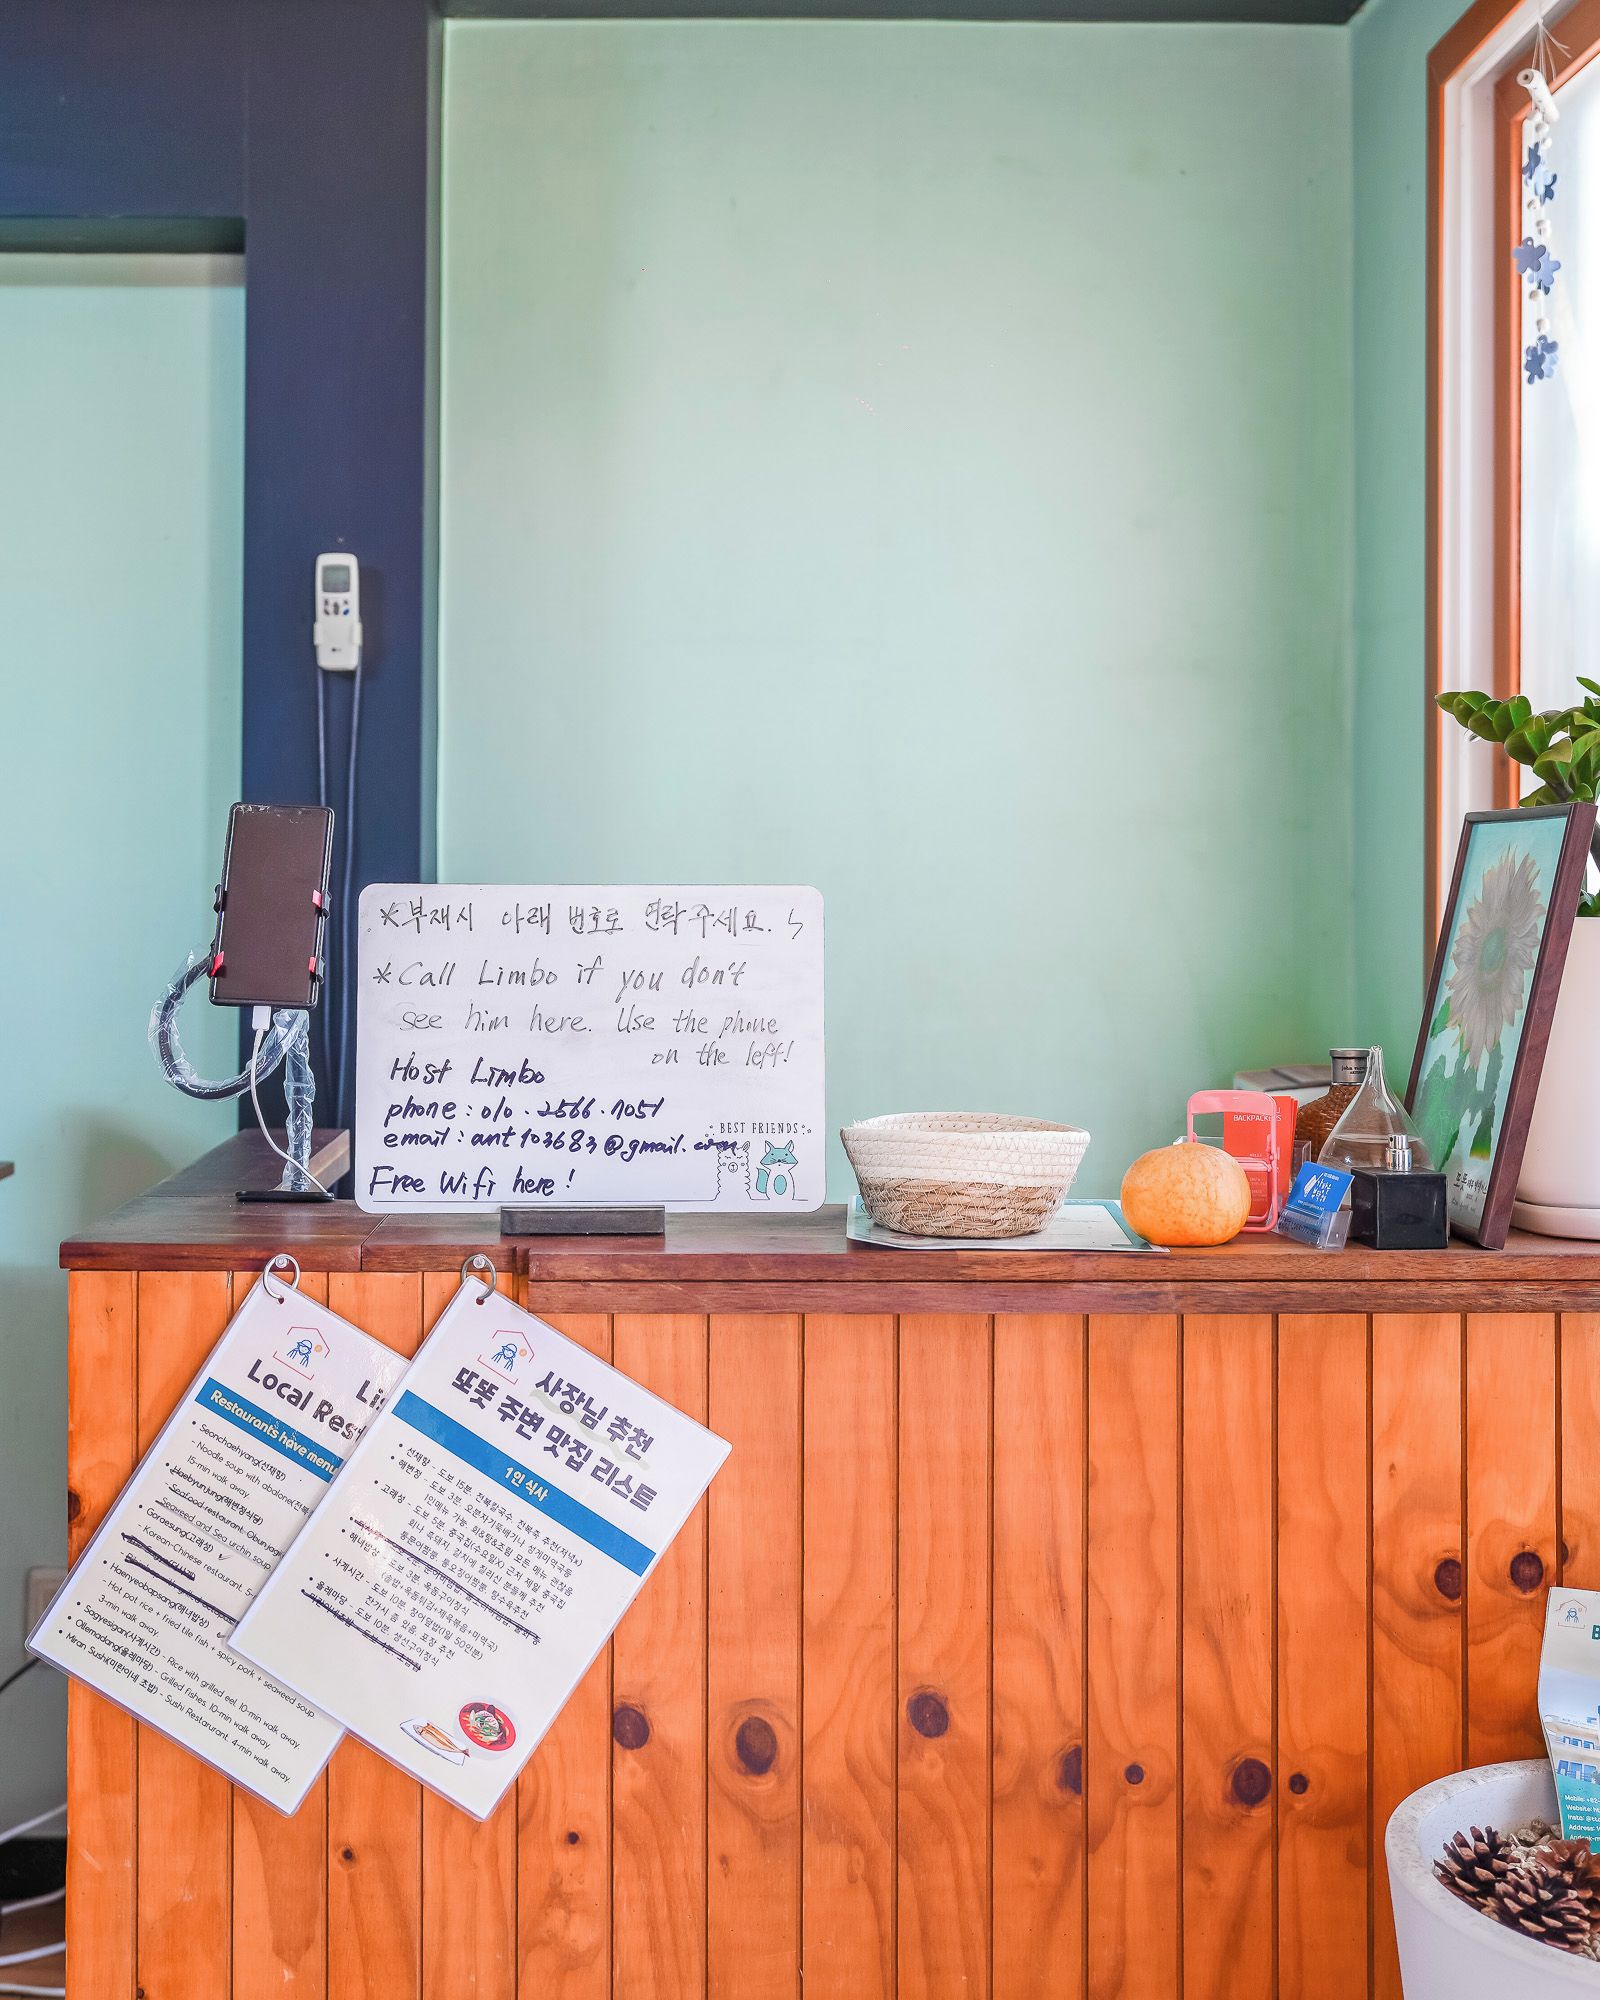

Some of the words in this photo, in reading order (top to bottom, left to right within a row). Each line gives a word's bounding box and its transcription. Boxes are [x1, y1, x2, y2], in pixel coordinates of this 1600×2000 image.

[502, 903, 551, 935] 아래
[569, 905, 624, 935] 번호로
[399, 962, 456, 986] Call
[478, 957, 558, 986] Limbo
[577, 955, 604, 984] if
[615, 969, 663, 1003] you
[681, 956, 746, 988] don't
[465, 1003, 509, 1031] him
[530, 1003, 592, 1033] here.
[617, 1004, 655, 1034] Use
[673, 1009, 708, 1033] the
[718, 1010, 778, 1039] phone
[390, 1051, 452, 1084] Host
[471, 1057, 545, 1087] Limbo
[651, 1049, 678, 1064] on
[696, 1041, 730, 1066] the
[746, 1040, 794, 1069] left!
[720, 1122, 746, 1134] BEST
[752, 1122, 799, 1134] FRIENDS
[369, 1166, 426, 1196] Free
[440, 1166, 496, 1200] Wifi
[247, 1358, 313, 1411] Local
[210, 1389, 279, 1438] Restaurants
[278, 1431, 307, 1456] have
[534, 1370, 608, 1430] 사장님
[606, 1415, 654, 1460] 추천
[186, 1455, 210, 1473] 15-min
[211, 1472, 228, 1485] walk
[196, 1441, 223, 1462] Noodle
[224, 1460, 243, 1474] soup
[245, 1472, 260, 1485] with
[406, 1447, 430, 1466] 선채향
[437, 1468, 454, 1483] 도보
[496, 1394, 544, 1440] 주변
[543, 1424, 593, 1472] 맛집
[590, 1456, 657, 1511] 리스트
[398, 1459, 422, 1479] 해변정
[429, 1480, 446, 1495] 도보
[505, 1467, 525, 1487] 1인
[525, 1479, 548, 1501] 식사
[142, 1525, 202, 1565] Korean-Chinese
[146, 1507, 213, 1552] Goraesung(고래성)
[159, 1495, 196, 1523] Seaweed
[194, 1517, 212, 1533] and
[211, 1527, 229, 1543] Sea
[227, 1538, 253, 1558] urchin
[380, 1484, 405, 1503] 고래성
[412, 1505, 429, 1520] 도보
[505, 1565, 523, 1581] 근처
[524, 1577, 540, 1593] 제일
[542, 1589, 566, 1609] 중국집
[332, 1557, 364, 1581] 사계시간
[371, 1582, 388, 1597] 도보
[407, 1518, 424, 1533] 회나
[528, 1597, 544, 1612] 추천
[513, 1553, 530, 1568] 모든
[532, 1565, 546, 1579] 메뉴
[98, 1594, 119, 1612] 3-min
[121, 1609, 137, 1622] walk
[138, 1621, 158, 1637] away.
[315, 1580, 347, 1605] 올레마당
[354, 1607, 372, 1622] 도보
[393, 1632, 439, 1666] 생선구이정식
[364, 1595, 389, 1616] 잔가시
[419, 1632, 436, 1647] 포장
[438, 1644, 455, 1659] 추천
[107, 1580, 122, 1594] Hot
[122, 1592, 138, 1603] pot
[138, 1601, 153, 1613] rice
[161, 1613, 181, 1629] fried
[181, 1626, 193, 1637] tile
[194, 1634, 208, 1648] fish
[216, 1650, 236, 1666] spicy
[236, 1663, 255, 1678] pork
[263, 1680, 296, 1704] seaweed
[295, 1702, 314, 1718] soup.
[83, 1604, 160, 1656] Sagyesigan(사계시간)
[166, 1656, 183, 1671] Rice
[184, 1669, 199, 1681] with
[199, 1680, 224, 1697] grilled
[238, 1702, 261, 1723] 10-min
[263, 1720, 278, 1734] walk
[280, 1732, 300, 1749] away.
[65, 1632, 86, 1650] Miran
[164, 1694, 184, 1711] Sushi
[231, 1739, 252, 1756] 4-min
[253, 1754, 268, 1768] walk
[268, 1765, 292, 1785] away.
[160, 1672, 184, 1691] Grilled
[184, 1687, 206, 1707] fishes.
[208, 1703, 232, 1723] 10-min
[233, 1721, 249, 1734] walk
